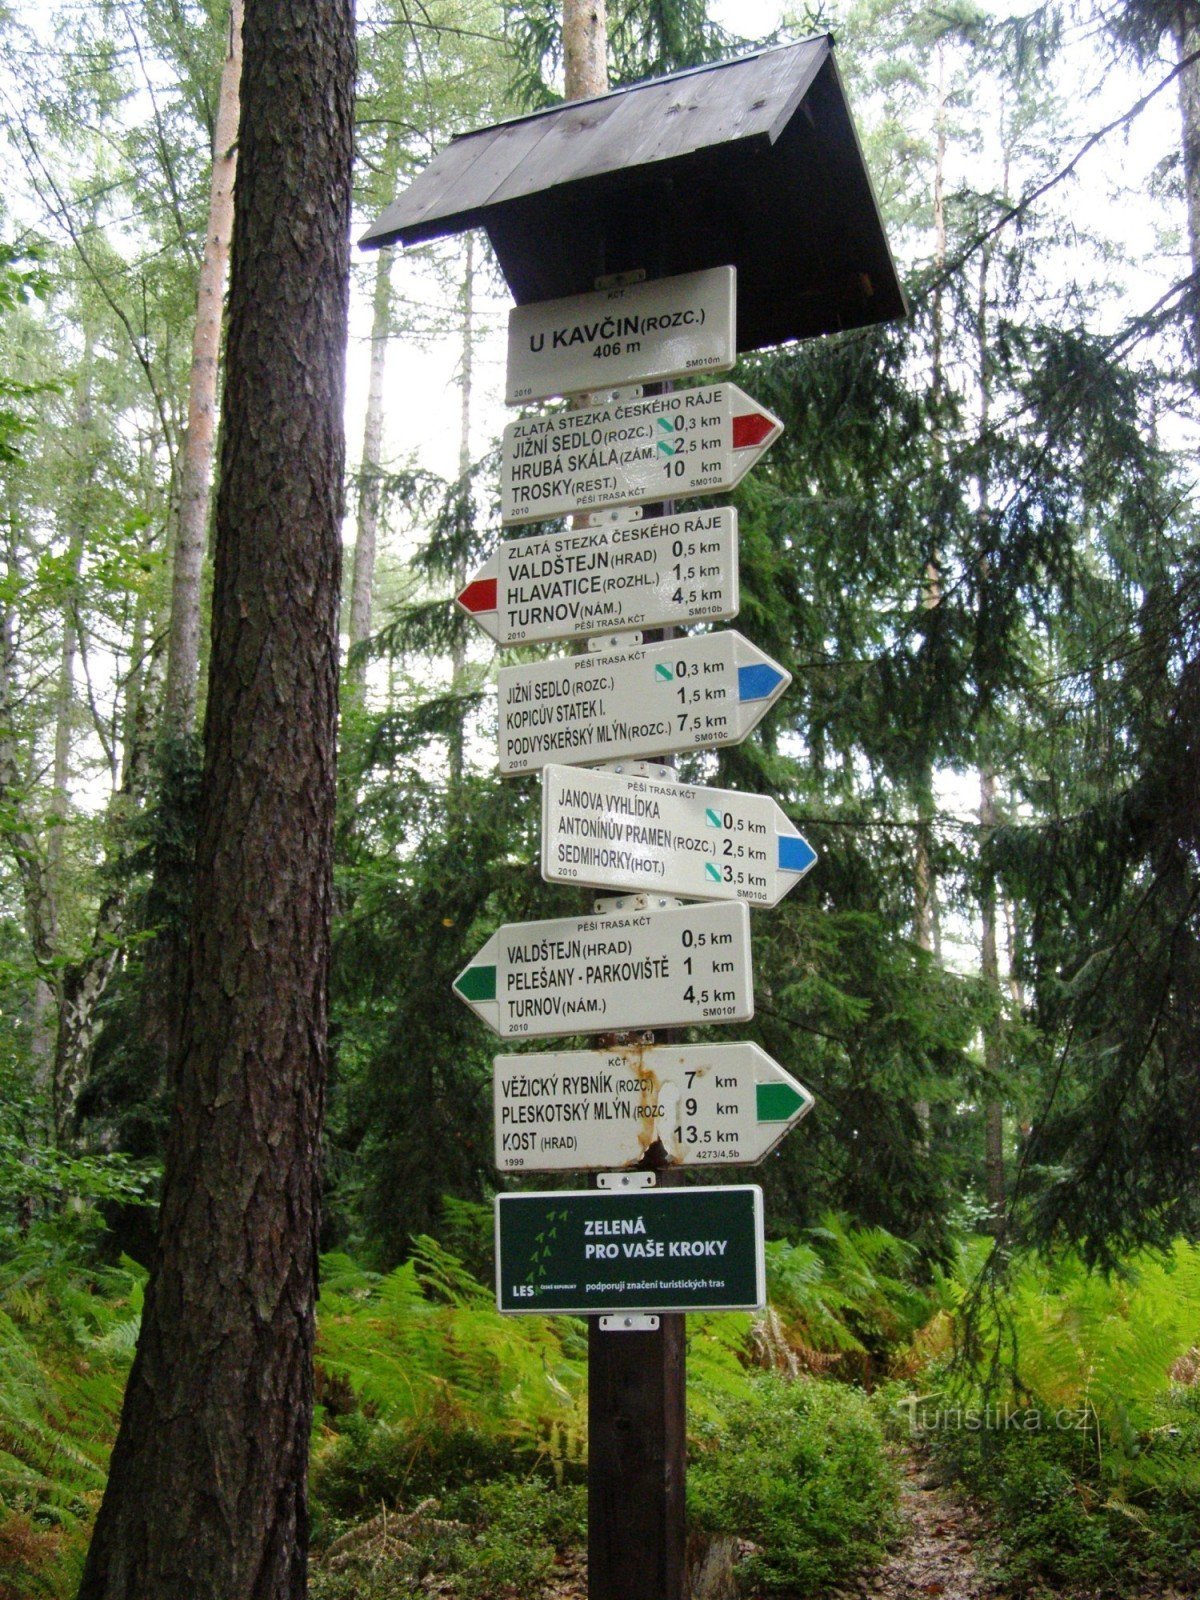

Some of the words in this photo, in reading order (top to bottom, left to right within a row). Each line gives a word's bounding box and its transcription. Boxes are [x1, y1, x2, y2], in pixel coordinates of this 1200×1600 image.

[530, 334, 544, 352] U
[593, 343, 621, 358] 406
[627, 341, 640, 353] m
[686, 357, 720, 368] SM010m
[514, 388, 532, 397] 2010
[513, 420, 554, 438] ZLATÁ
[559, 411, 611, 432] STEZKA
[615, 398, 681, 420] ČESKÉHO
[685, 391, 722, 407] RÁJE
[512, 435, 547, 459] JIŽNÍ
[674, 414, 696, 432] 0,3
[702, 415, 721, 428] km
[511, 457, 563, 481] HRUBÁ
[674, 437, 697, 456] 2,5
[702, 438, 721, 450] km
[663, 460, 685, 478] 10
[702, 461, 721, 473] km
[690, 477, 722, 487] SM010a
[577, 495, 595, 506] PĚŠÍ
[597, 490, 626, 503] TRASA
[628, 487, 645, 498] KČT
[511, 506, 529, 516] 2010
[509, 542, 551, 560] ZLATÁ
[555, 534, 607, 552] STEZKA
[612, 522, 679, 544] ČESKÉHO
[684, 516, 721, 531] RÁJE
[672, 540, 696, 558] 0,5
[700, 543, 720, 553] km
[672, 564, 695, 581] 1,5
[699, 566, 719, 577] km
[672, 588, 697, 605] 4,5
[702, 590, 722, 601] km
[689, 605, 722, 616] SM010b
[575, 620, 595, 630] PĚŠÍ
[597, 617, 625, 629] TRASA
[627, 615, 645, 625] KČT
[508, 631, 525, 640] 2010
[575, 658, 595, 669] PĚŠÍ
[597, 655, 626, 667] TRASA
[628, 651, 645, 663] KČT
[506, 680, 532, 704] JIŽNÍ
[676, 661, 699, 678] 0,3
[703, 661, 724, 674] km
[506, 707, 552, 730] KOPICŮV
[556, 701, 597, 722] STATEK
[599, 699, 606, 716] I.
[678, 687, 700, 704] 1,5
[705, 688, 726, 700] km
[507, 726, 592, 756] PODVYSKEŘSKÝ
[677, 713, 701, 732] 7,5
[706, 714, 727, 727] km
[695, 732, 728, 742] SM010c
[509, 759, 528, 768] 2010
[627, 782, 646, 793] PĚŠÍ
[650, 785, 678, 797] TRASA
[679, 790, 696, 799] KČT
[558, 789, 602, 813] JANOVA
[606, 795, 660, 819] VYHLÍDKA
[723, 813, 744, 832] 0,5
[748, 820, 766, 834] km
[558, 816, 623, 841] ANTONÍNŮV
[723, 839, 744, 858] 2,5
[748, 847, 766, 860] km
[558, 868, 577, 877] 2010
[723, 866, 744, 884] 3,5
[748, 873, 766, 887] km
[737, 889, 767, 901] SM010d
[578, 921, 598, 932] PĚŠÍ
[600, 919, 630, 929] TRASA
[633, 916, 651, 927] KČT
[682, 930, 706, 949] 0,5
[711, 932, 732, 944] km
[507, 967, 574, 991] PELEŠANY
[586, 956, 669, 983] PARKOVIŠTĚ
[684, 958, 692, 974] 1
[712, 961, 734, 973] km
[683, 986, 709, 1005] 4,5
[714, 990, 735, 1001] km
[703, 1007, 736, 1016] SM010f
[509, 1024, 528, 1032] 2010
[608, 1057, 627, 1067] KČT
[501, 1074, 558, 1098] VĚŽICKÝ
[562, 1072, 613, 1095] RYBNÍK
[685, 1071, 696, 1089] 7
[715, 1076, 737, 1088] km
[502, 1097, 589, 1125] PLESKOTSKÝ
[594, 1096, 631, 1121] MLÝN
[686, 1098, 697, 1116] 9
[717, 1102, 738, 1115] km
[502, 1132, 536, 1151] KOST
[541, 1136, 577, 1151] (HRAD)
[717, 1130, 739, 1143] km
[505, 1158, 524, 1166] 1999
[584, 1216, 646, 1236] ZELENÁ
[585, 1244, 619, 1259] PRO
[623, 1240, 664, 1258] VAŠE
[669, 1241, 727, 1257] KROKY
[585, 1280, 624, 1293] podporují
[626, 1280, 658, 1290] značení
[659, 1278, 707, 1290] turistických
[708, 1279, 725, 1288] tras
